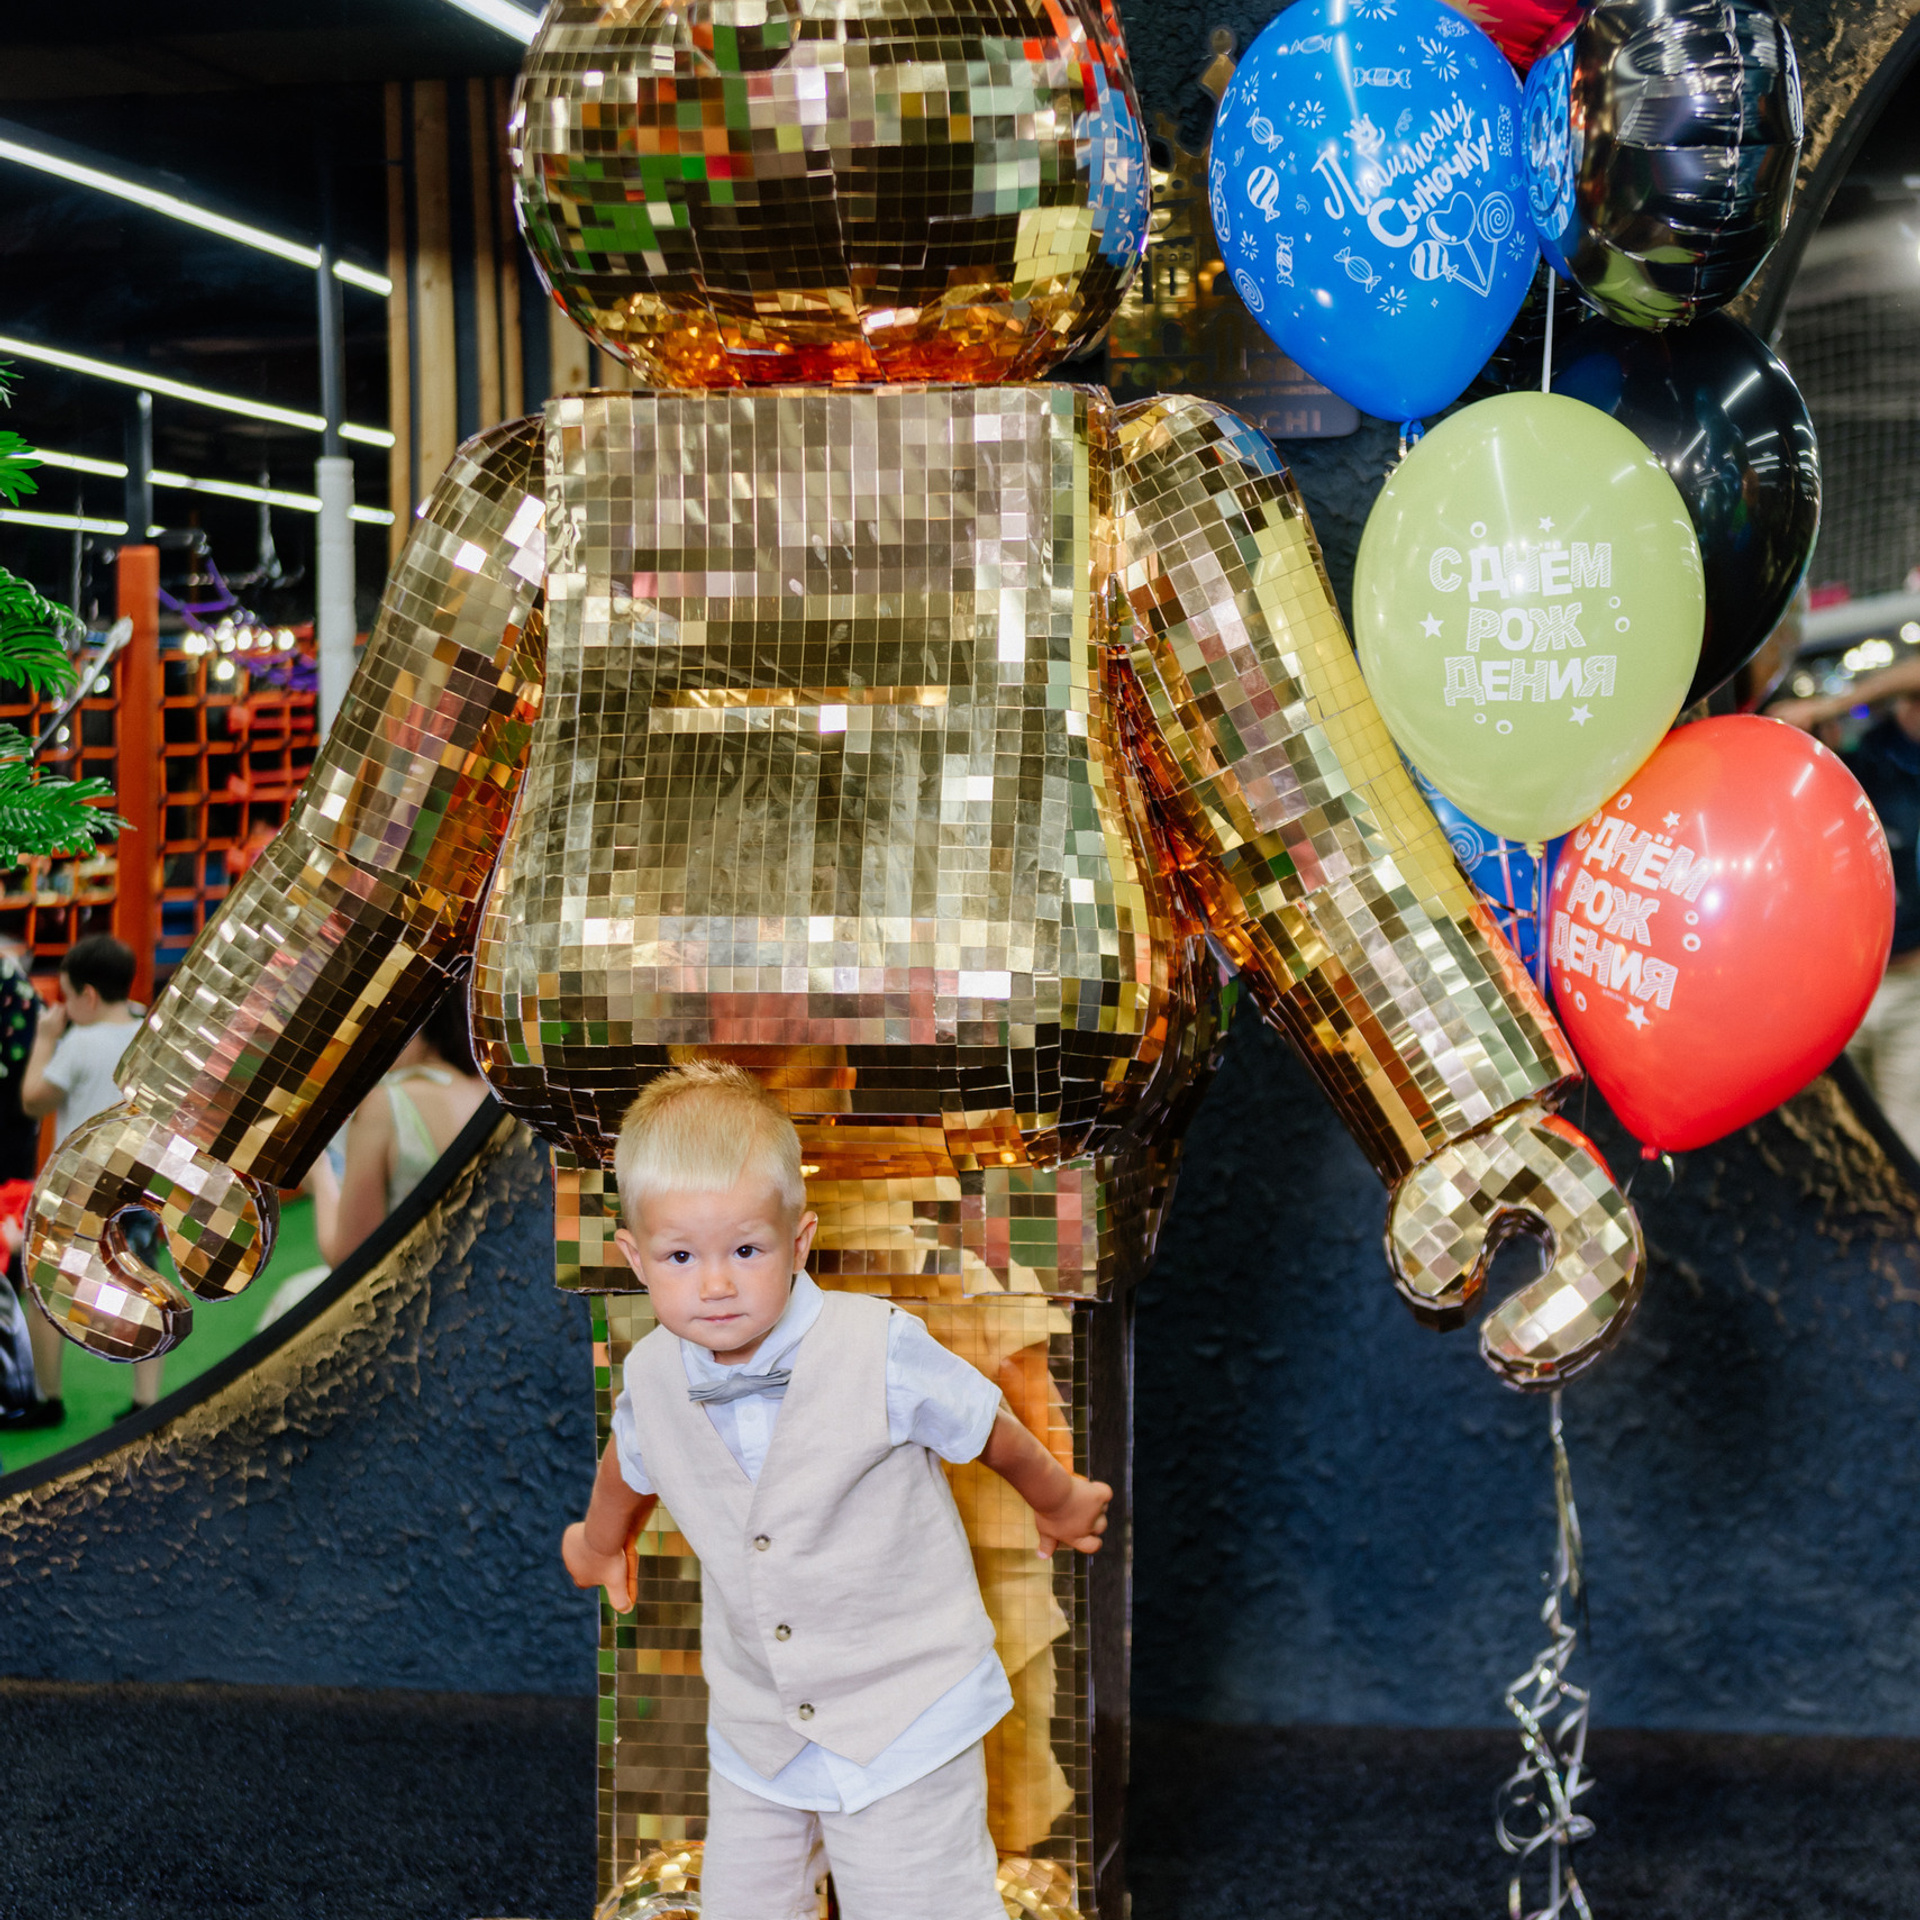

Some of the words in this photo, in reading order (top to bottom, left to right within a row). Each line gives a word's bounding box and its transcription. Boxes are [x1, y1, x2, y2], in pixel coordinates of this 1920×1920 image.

[1242, 409, 1321, 433] CHI
[1429, 546, 1463, 593] С
[1467, 540, 1612, 603] ДНЁМ
[1466, 602, 1587, 653] РОЖ
[1443, 655, 1618, 707] ДЕНИЯ
[1583, 815, 1713, 903] ДНЁМ
[1566, 867, 1661, 948] РОЖ
[1552, 910, 1679, 1011] ДЕНИЯ
